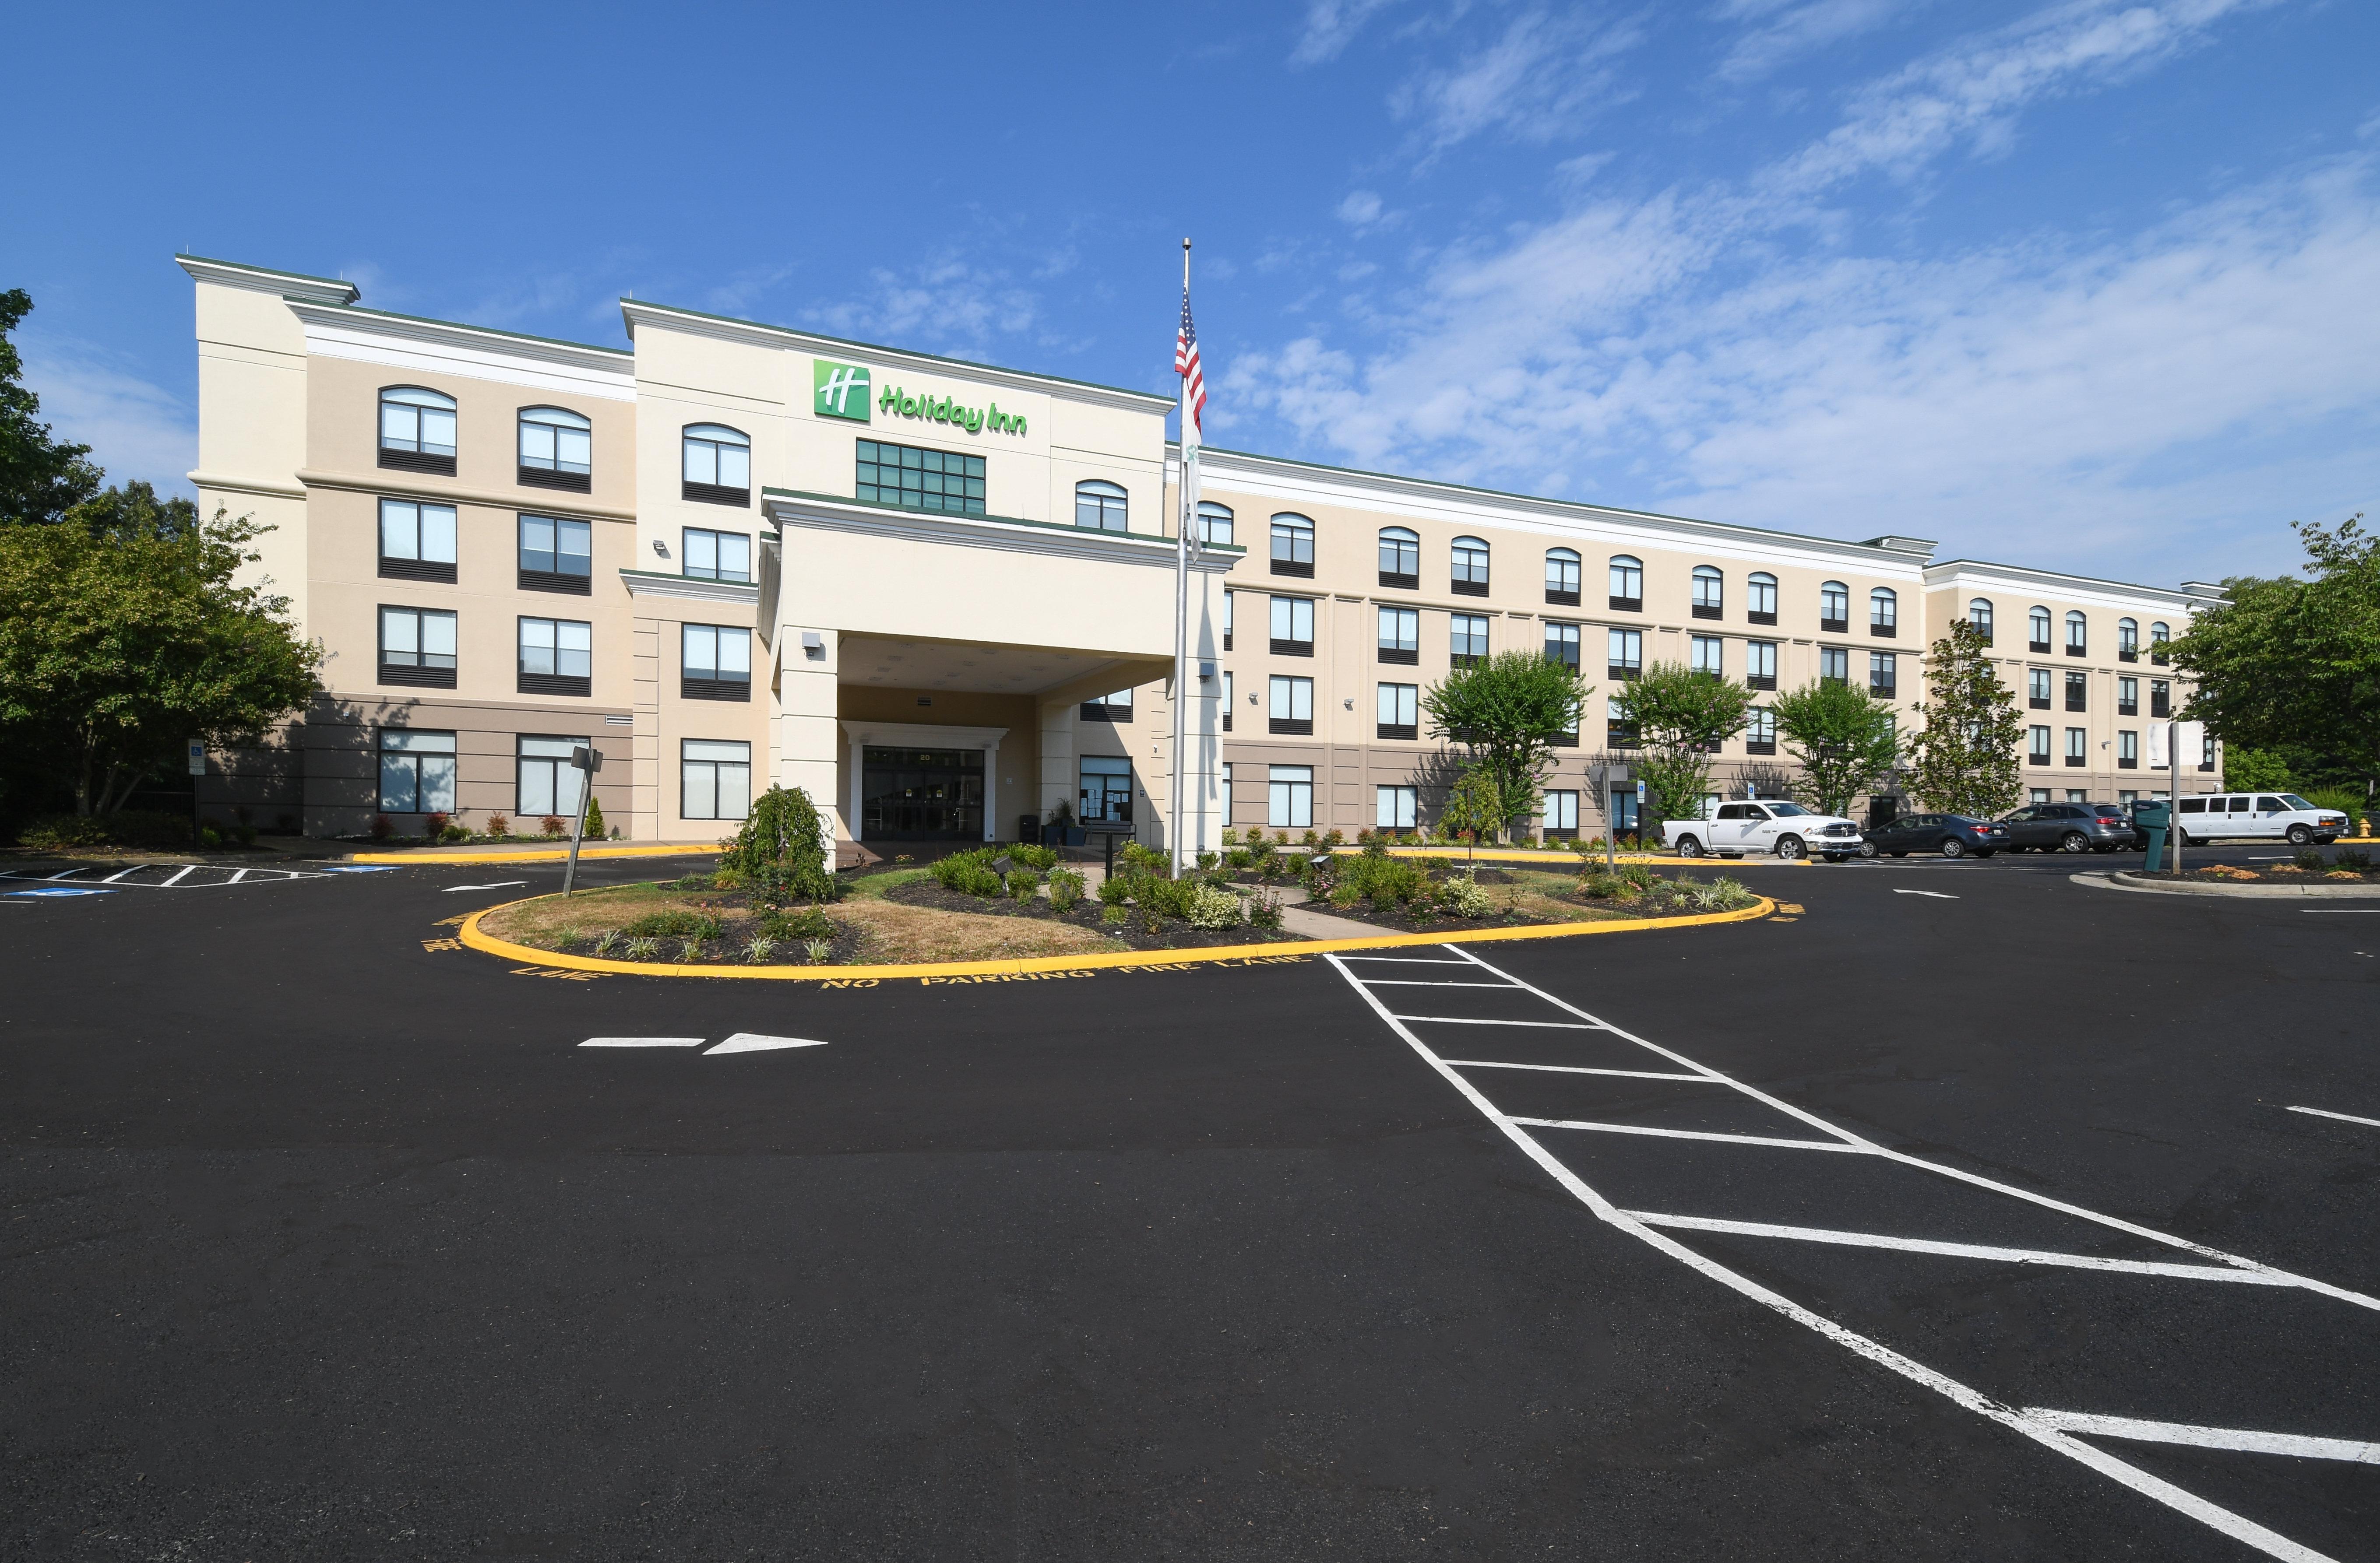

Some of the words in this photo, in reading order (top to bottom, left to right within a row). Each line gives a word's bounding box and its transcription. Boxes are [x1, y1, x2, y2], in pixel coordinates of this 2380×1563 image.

[879, 385, 984, 432] Holiday
[987, 403, 1026, 433] Inn
[820, 980, 879, 989] NO
[921, 971, 1095, 986] PARKING
[1119, 963, 1201, 973] FIRE
[1214, 956, 1313, 967] LANE
